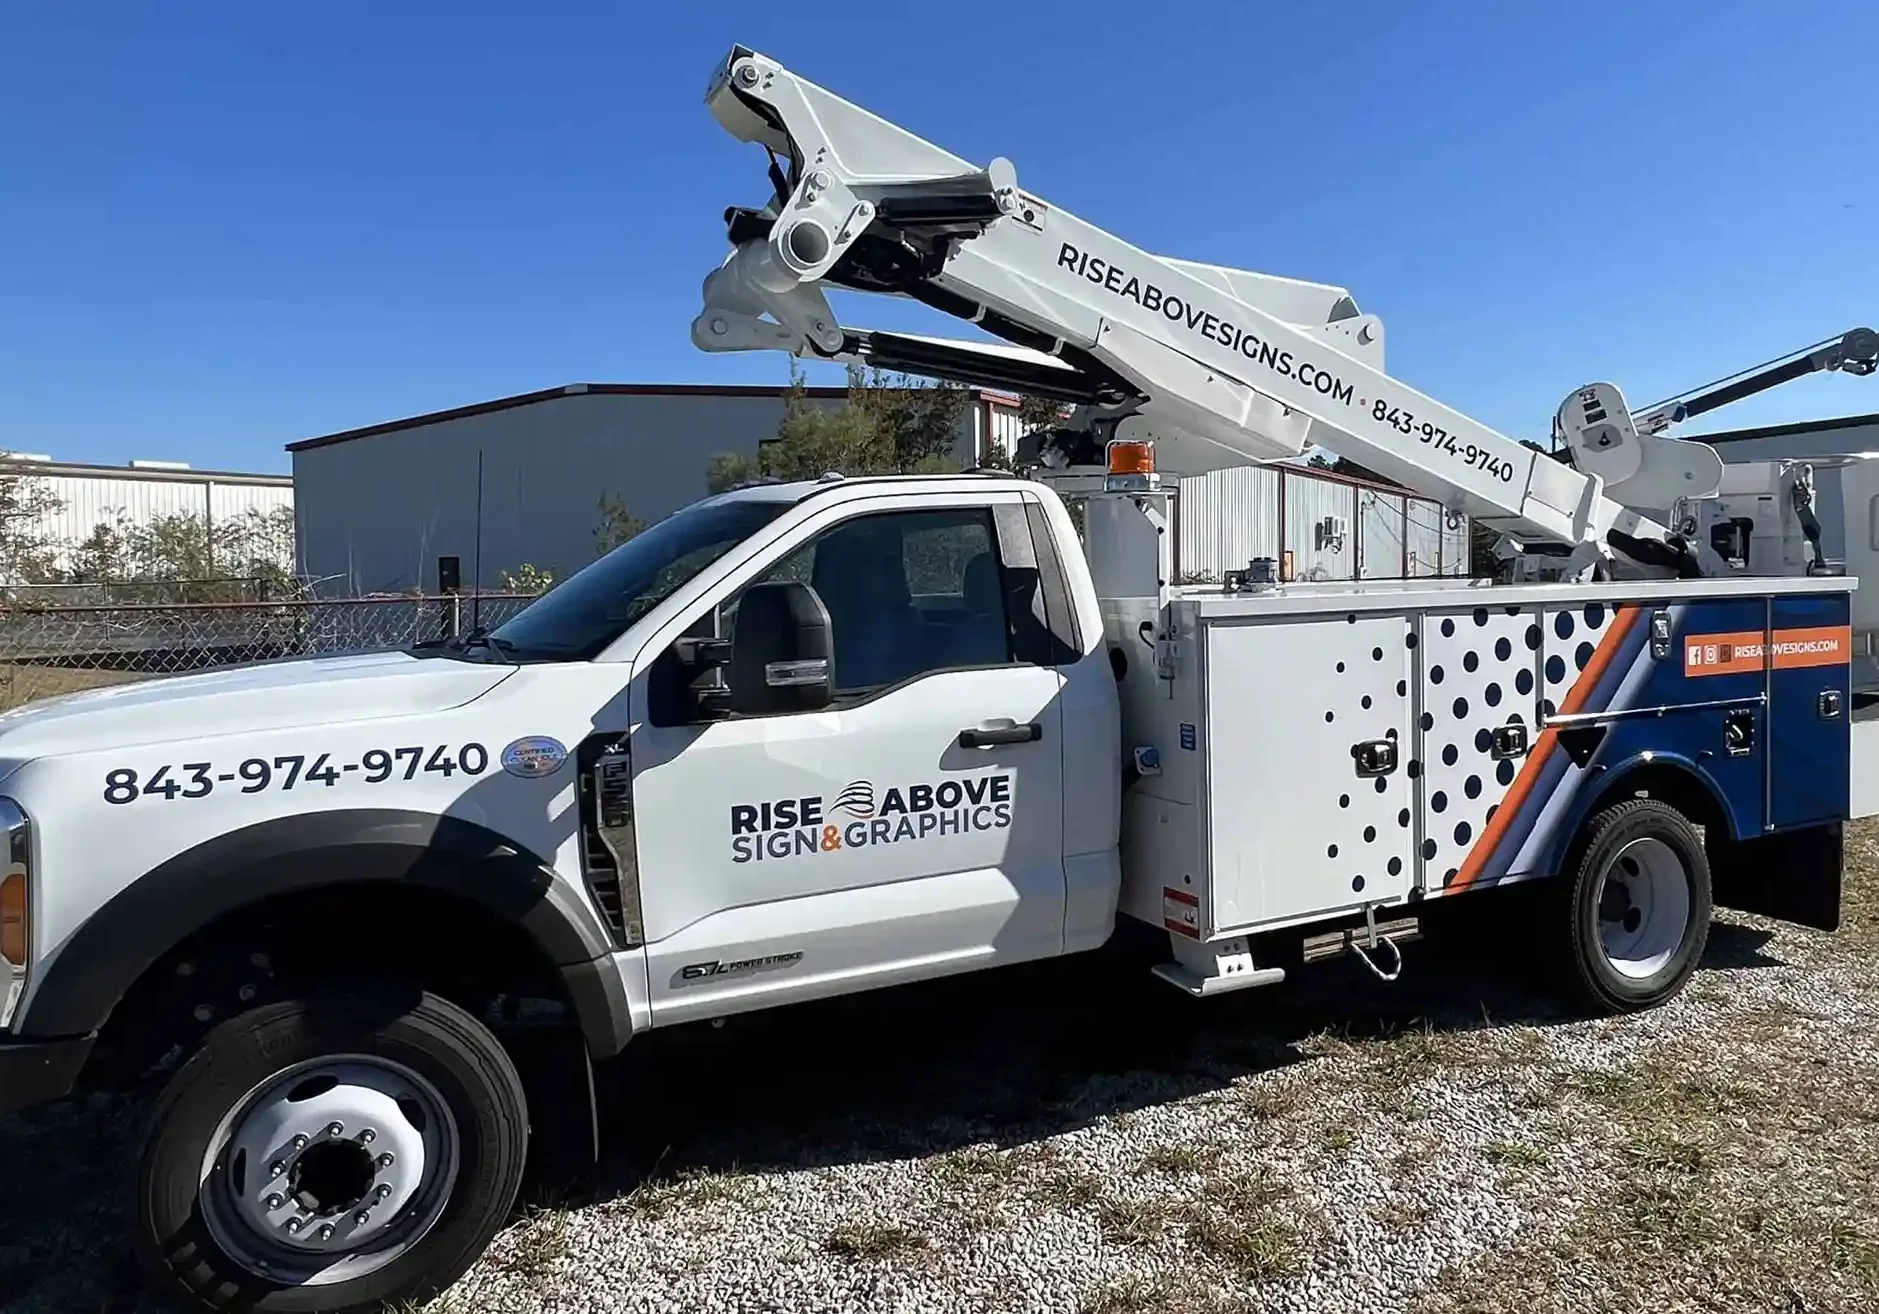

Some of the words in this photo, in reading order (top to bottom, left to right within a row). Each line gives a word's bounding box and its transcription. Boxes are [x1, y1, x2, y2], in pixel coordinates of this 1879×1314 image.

[1057, 242, 1353, 406] RISEABOVESIGNS.COM
[1372, 399, 1514, 483] 843-974-9740
[103, 742, 489, 805] 843-974-9740
[731, 796, 823, 835] RISE
[879, 775, 1010, 817] ABOVE
